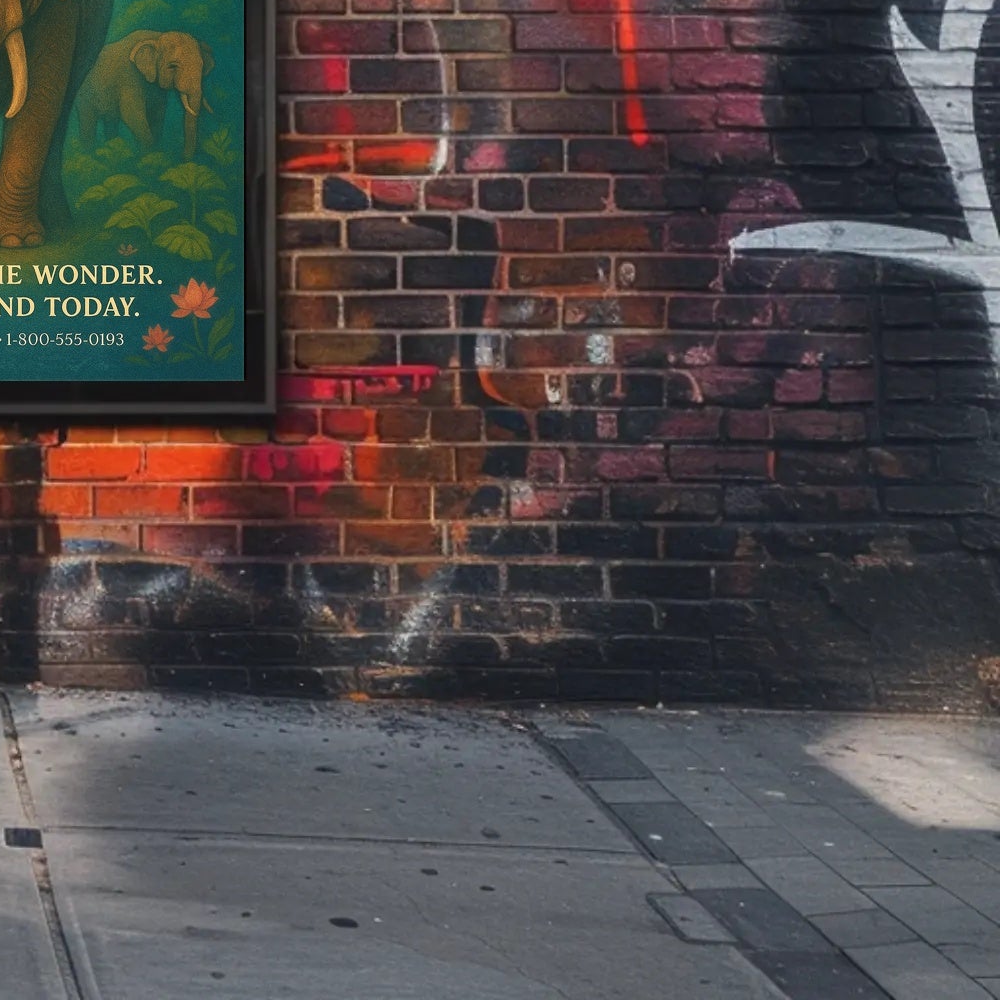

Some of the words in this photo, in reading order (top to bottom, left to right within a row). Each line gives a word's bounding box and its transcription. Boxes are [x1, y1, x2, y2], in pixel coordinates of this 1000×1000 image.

[31, 264, 163, 286] WONDER.
[43, 296, 140, 318] TODAY.
[6, 332, 125, 347] 1-800-555-0193
